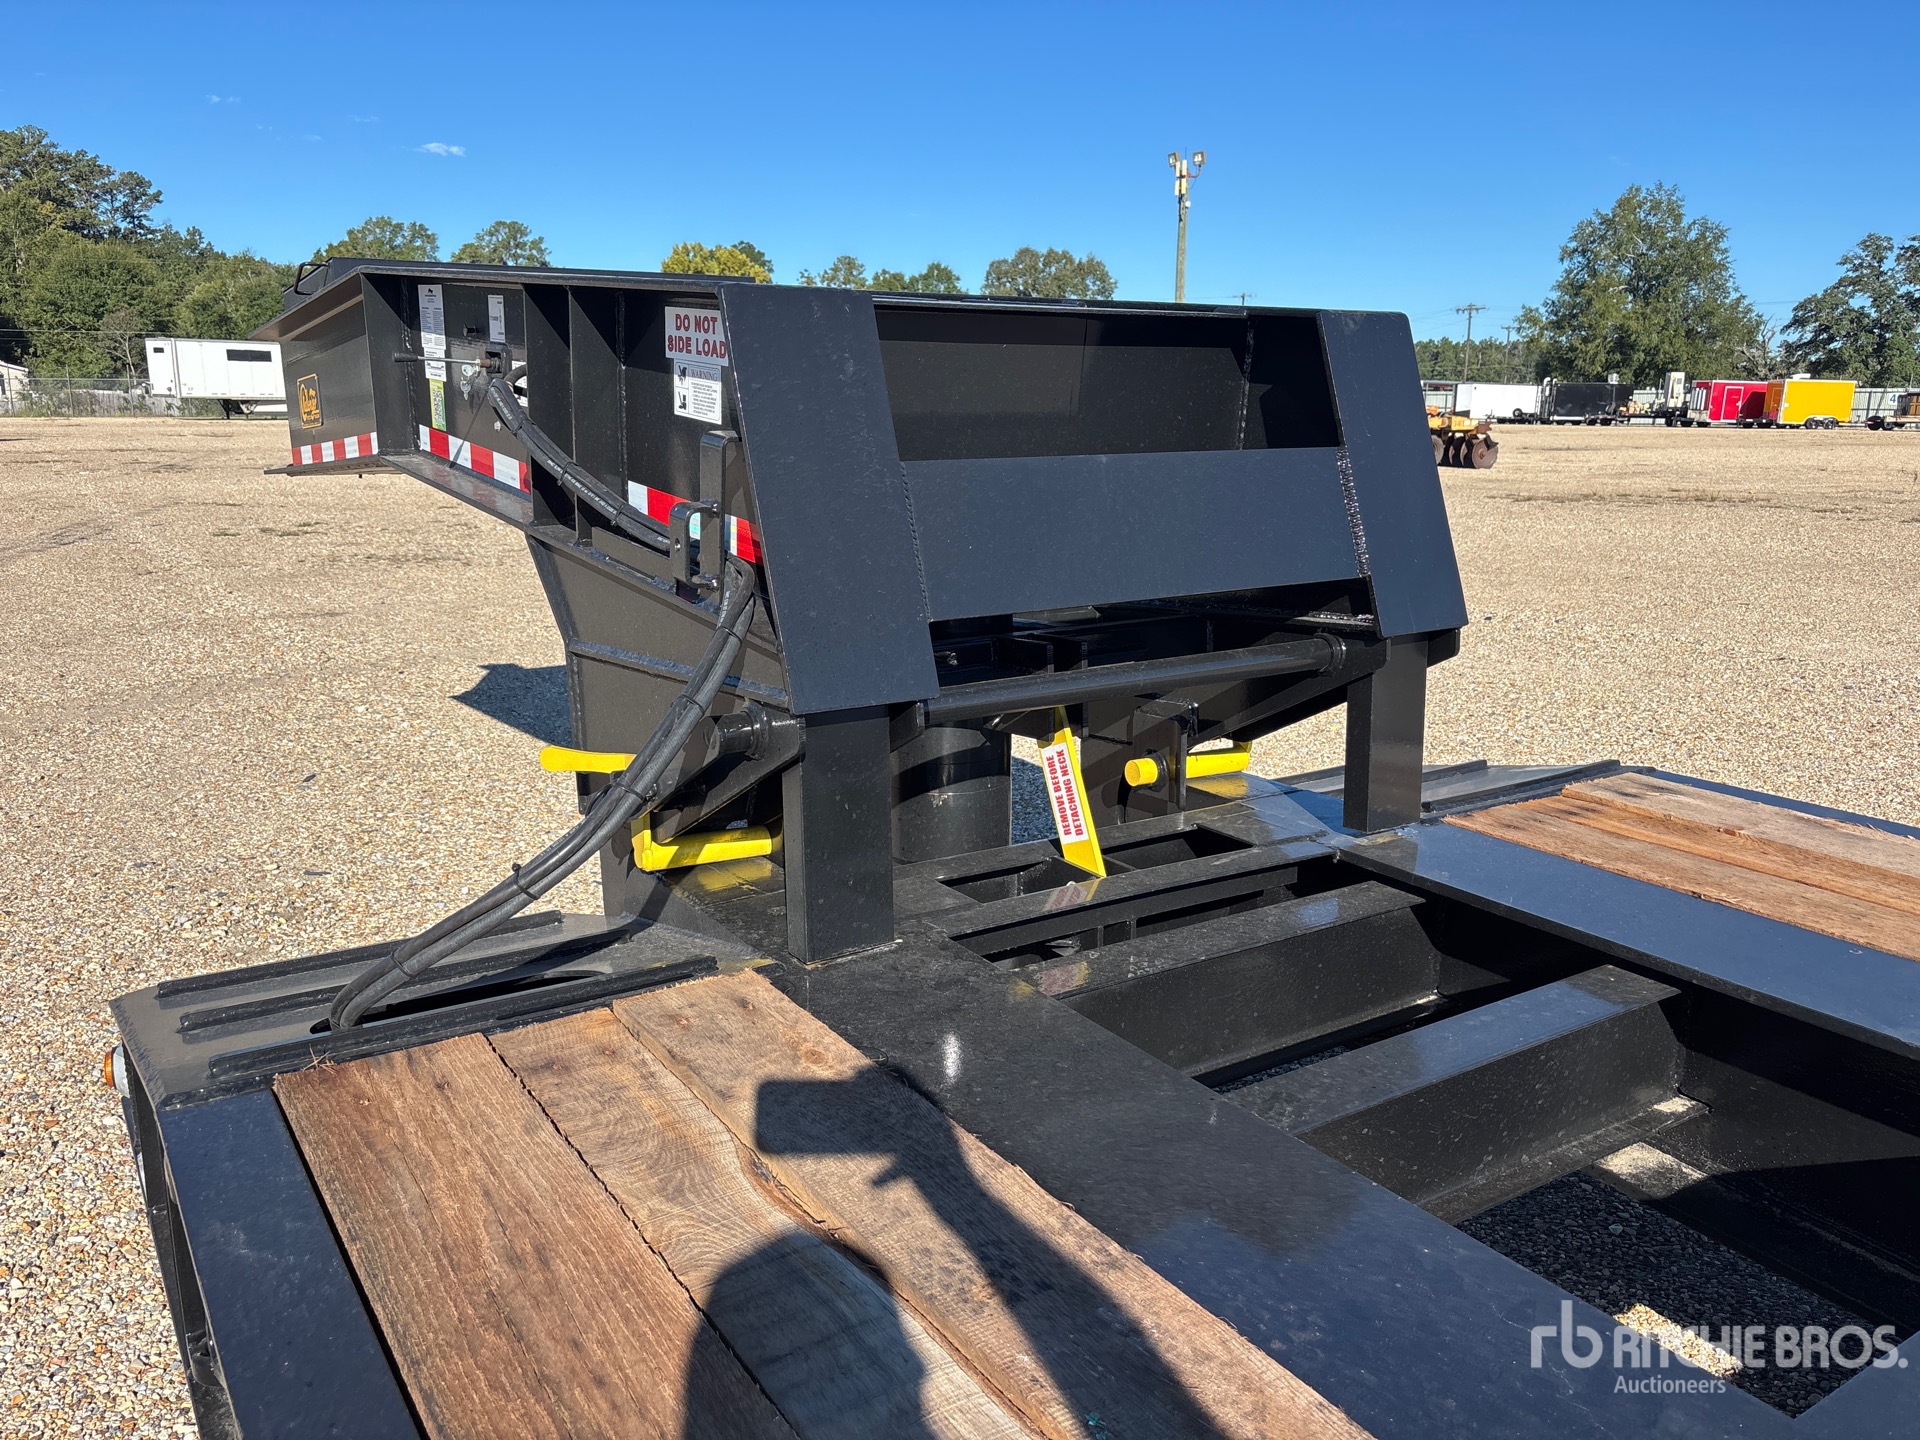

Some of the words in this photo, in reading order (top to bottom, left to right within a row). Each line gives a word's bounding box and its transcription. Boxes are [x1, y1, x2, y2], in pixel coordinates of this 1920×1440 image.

[675, 313, 691, 332] DO
[694, 315, 718, 335] NOT
[667, 334, 692, 354] SIDE
[695, 338, 727, 359] LOAD
[690, 368, 718, 382] WARNING
[1046, 754, 1062, 793] BEFORE
[1055, 748, 1070, 778] NECK
[1055, 793, 1072, 836] REMOVE
[1063, 778, 1084, 837] DETACHING
